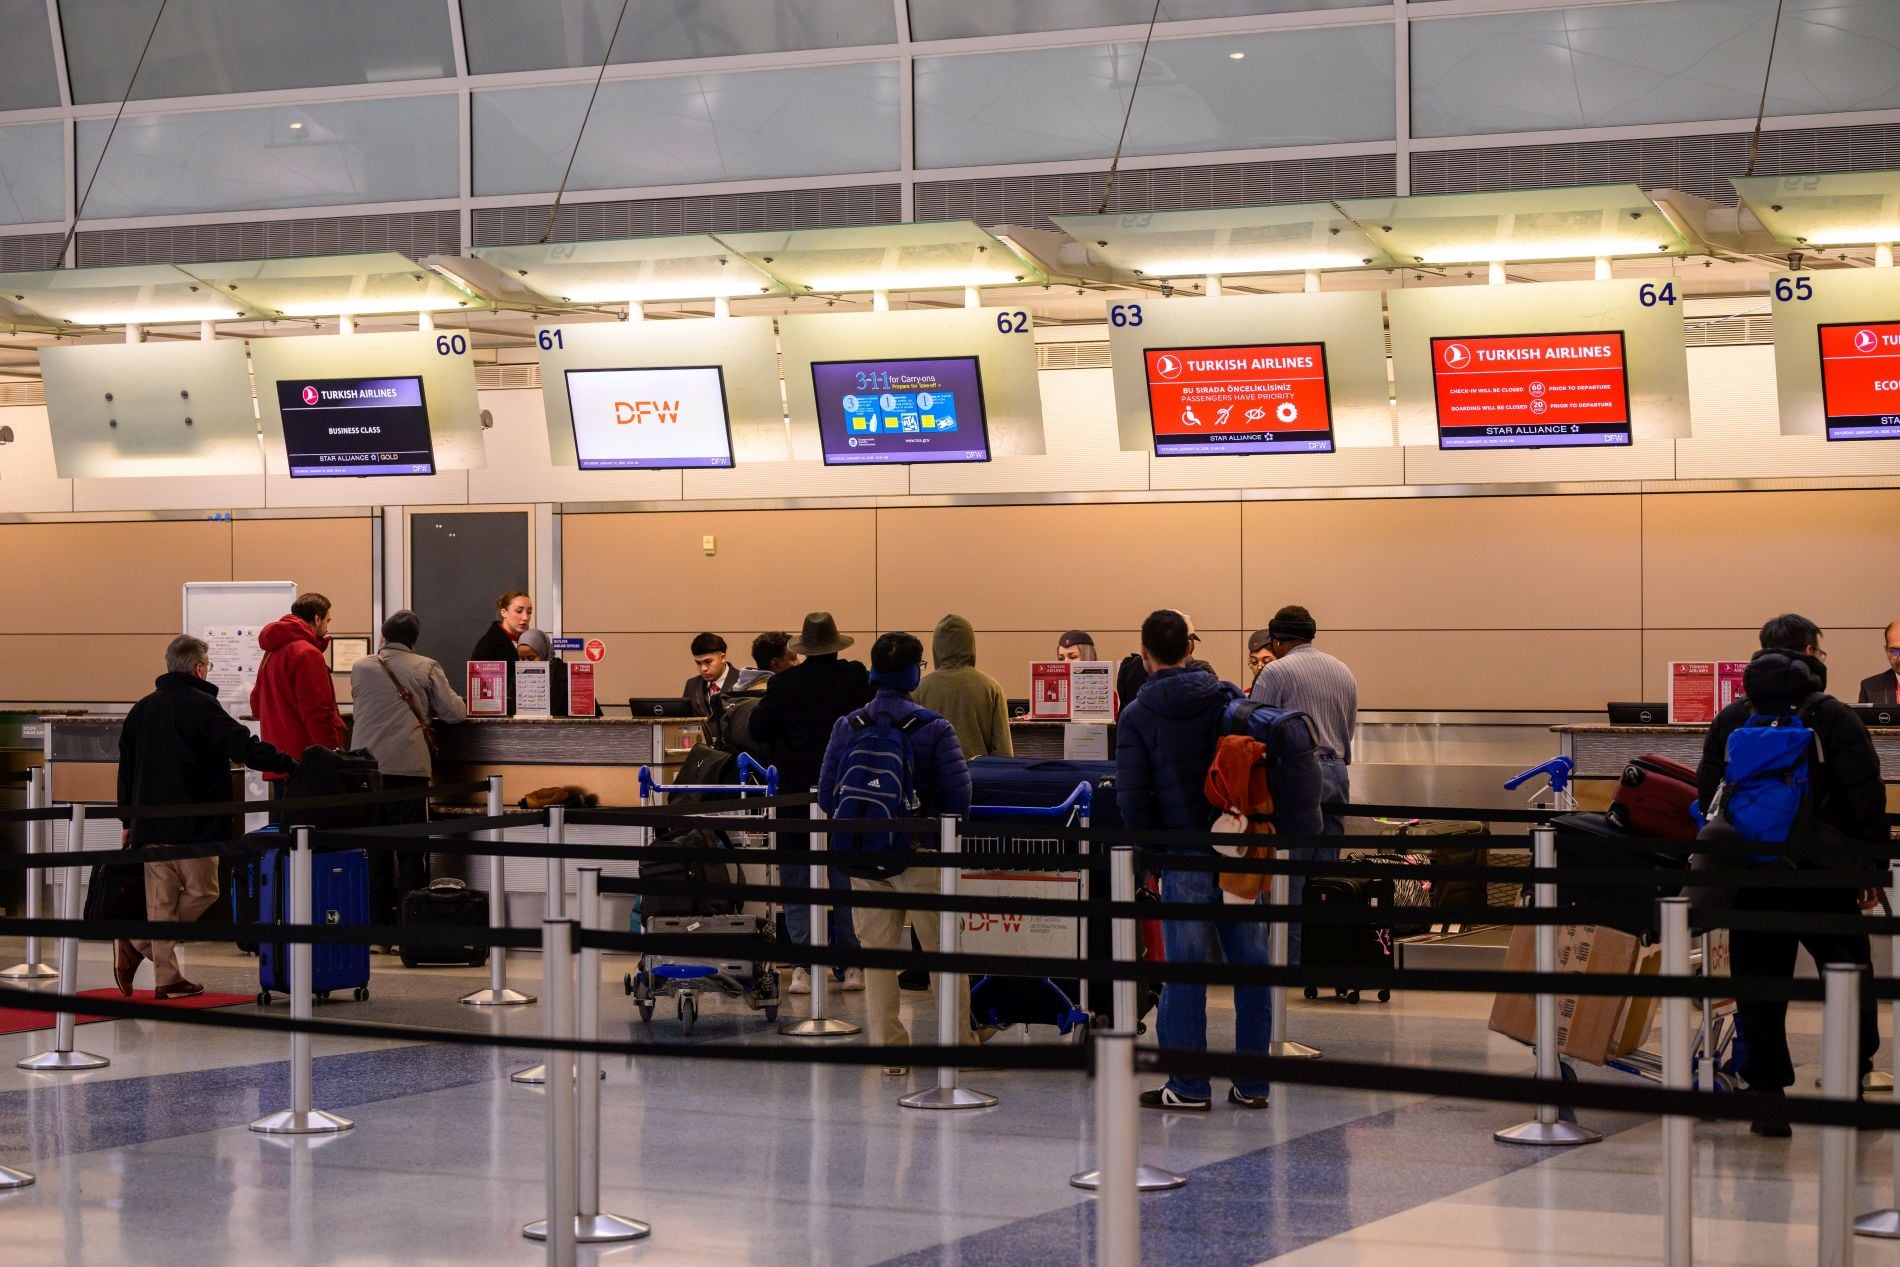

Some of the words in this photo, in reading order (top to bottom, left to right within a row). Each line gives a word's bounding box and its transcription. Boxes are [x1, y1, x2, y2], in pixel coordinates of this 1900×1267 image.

[1639, 282, 1677, 307] 64
[1775, 276, 1813, 302] 65
[996, 311, 1029, 334] 62
[1110, 304, 1143, 328] 63
[436, 334, 467, 356] 60
[538, 328, 564, 350] 61
[1882, 335, 1900, 346] TU
[1476, 348, 1541, 361] TURKISH
[1544, 346, 1612, 359] AIRLINES
[1187, 359, 1248, 372] TURKISH
[1251, 356, 1313, 370] AIRLINES
[856, 371, 890, 390] 3-1-1
[901, 375, 936, 384] Carry-ons
[321, 389, 358, 400] TURKISH
[359, 388, 398, 399] AIRLINES
[614, 400, 680, 425] DFW
[328, 426, 360, 435] BUSINESS
[360, 426, 381, 434] CLASS
[1486, 427, 1513, 435] STAR
[1515, 425, 1568, 434] ALLIANCE
[1604, 434, 1623, 442] DFW
[969, 912, 1024, 932] DFW
